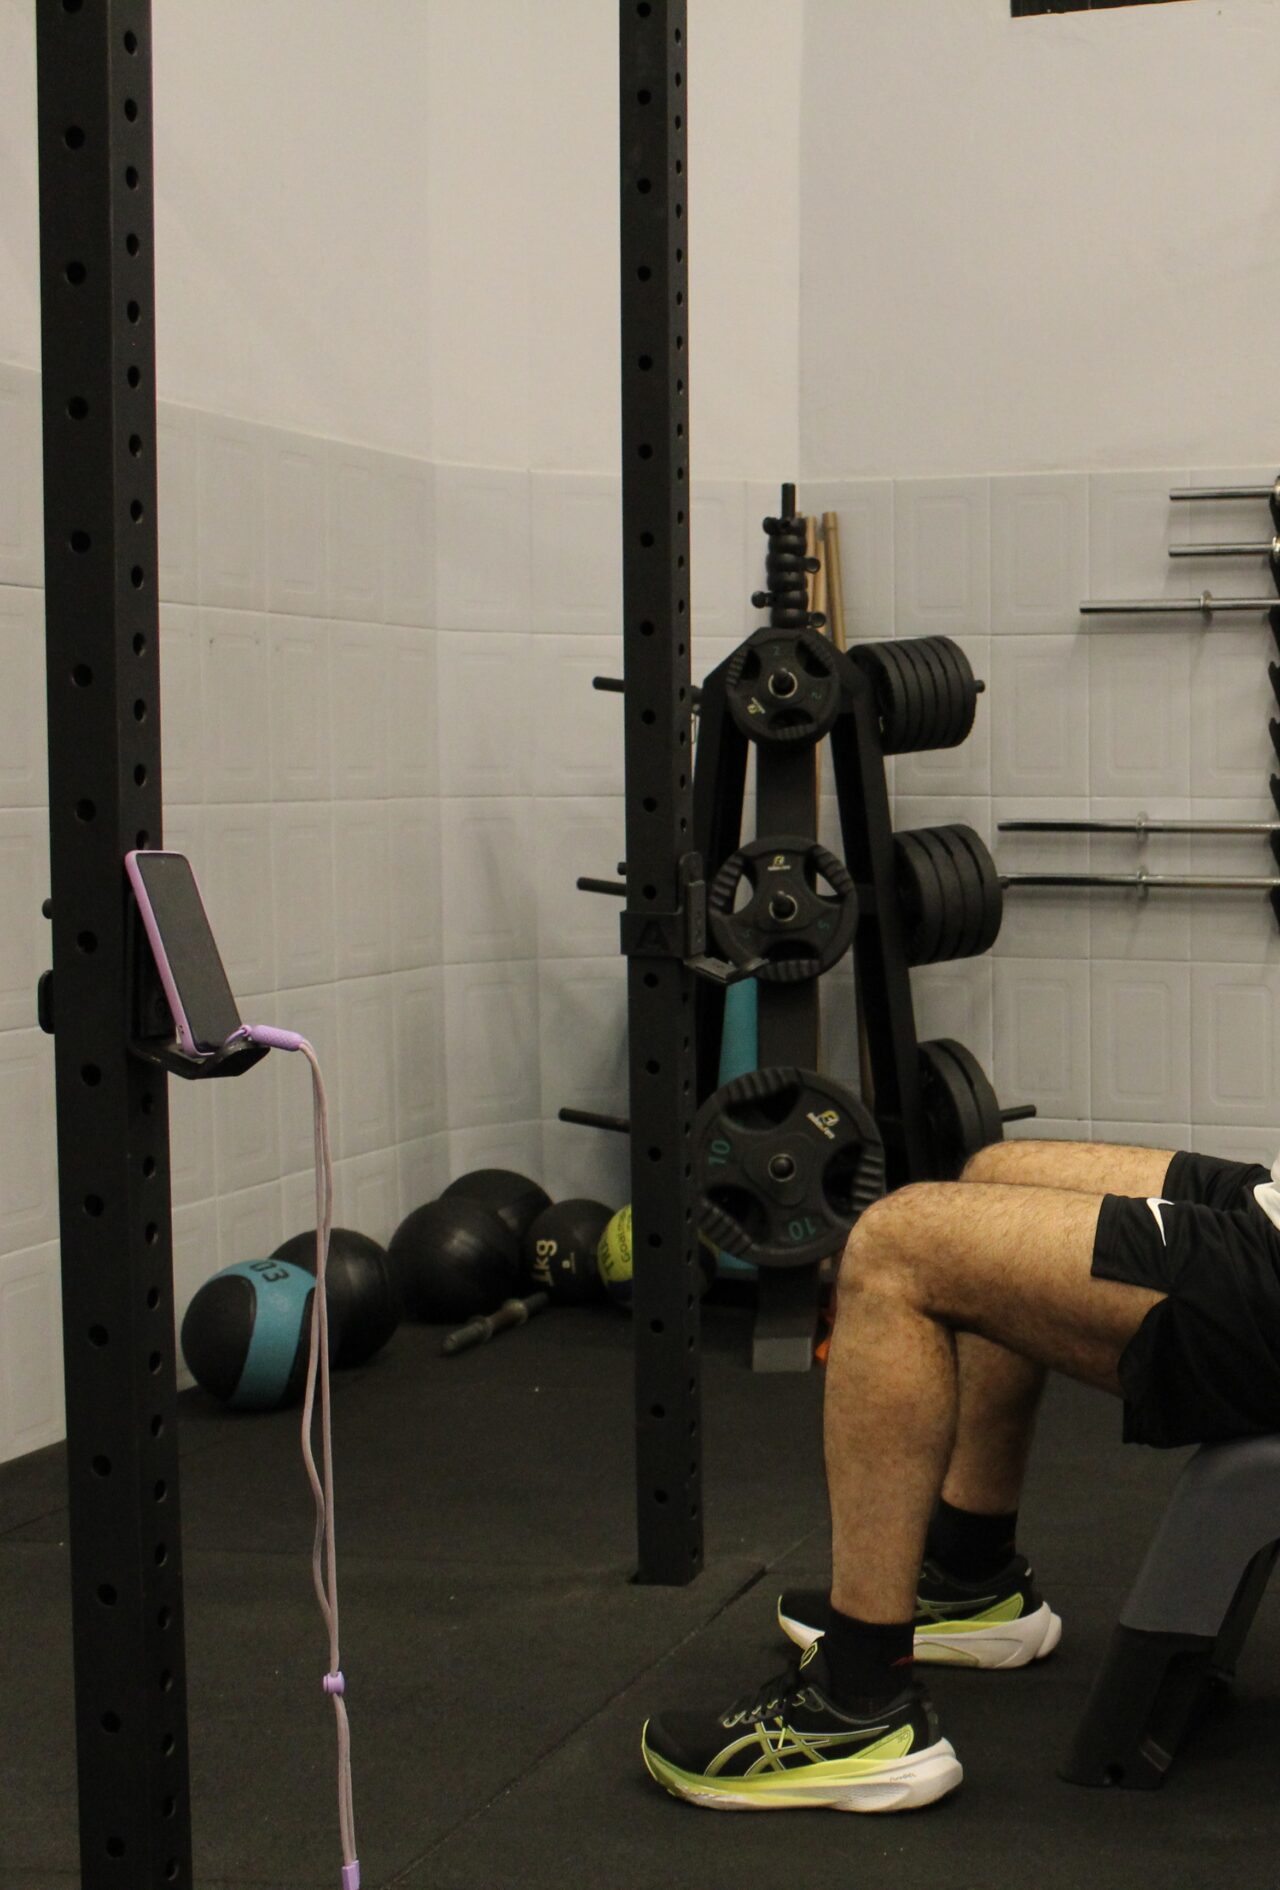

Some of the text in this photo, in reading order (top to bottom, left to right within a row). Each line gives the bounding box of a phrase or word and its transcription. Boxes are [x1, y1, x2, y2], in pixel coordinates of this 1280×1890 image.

[708, 1139, 731, 1167] 10
[788, 1217, 816, 1241] 10
[249, 1261, 289, 1282] 03
